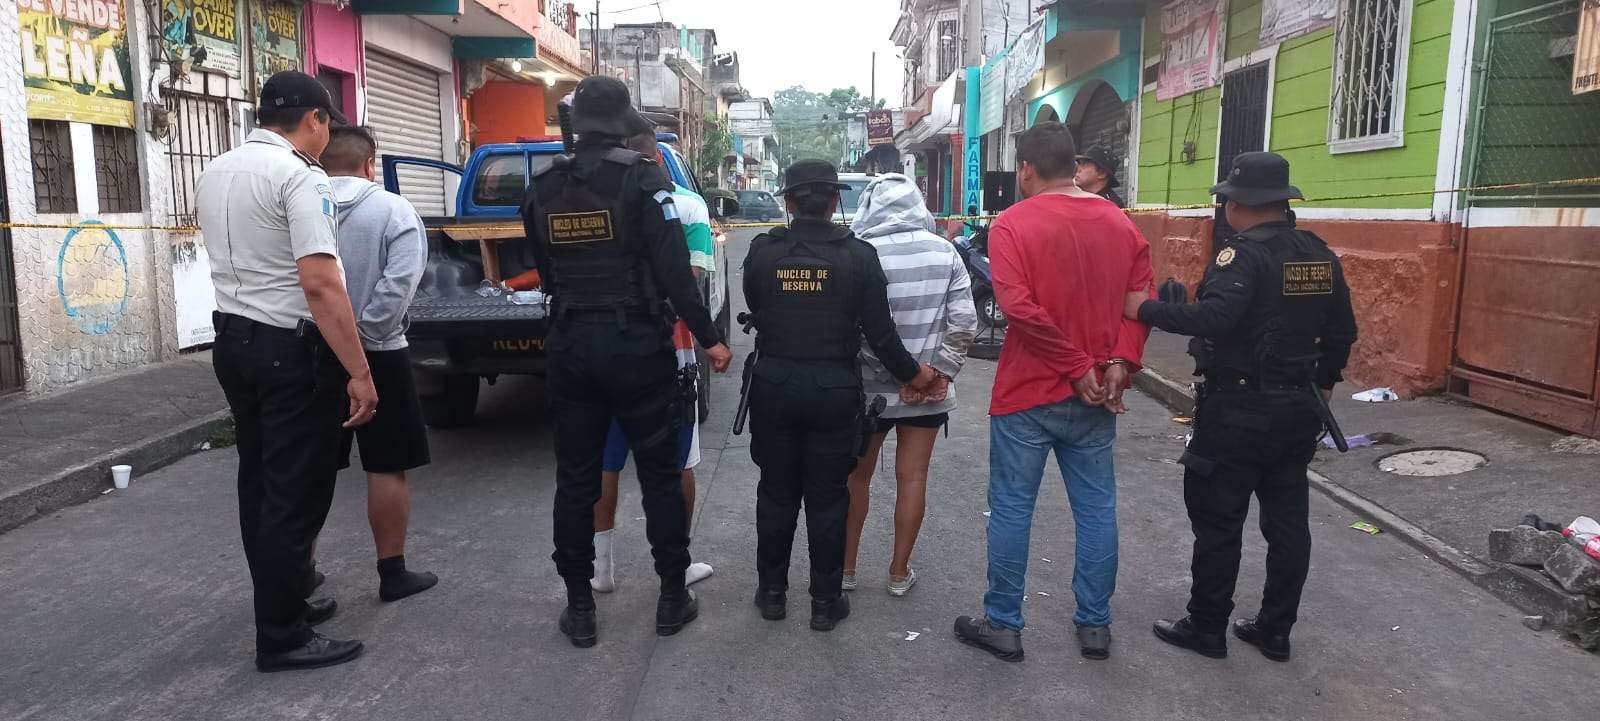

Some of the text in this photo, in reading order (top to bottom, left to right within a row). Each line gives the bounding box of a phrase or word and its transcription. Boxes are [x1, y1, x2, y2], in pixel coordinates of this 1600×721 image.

[51, 0, 120, 29] VENDE
[193, 6, 235, 41] OVER
[268, 16, 296, 40] OVER
[21, 28, 127, 92] LEÑA
[967, 137, 979, 215] FARMA
[776, 269, 828, 279] NUCLEO DE
[782, 281, 822, 291] RESERVA
